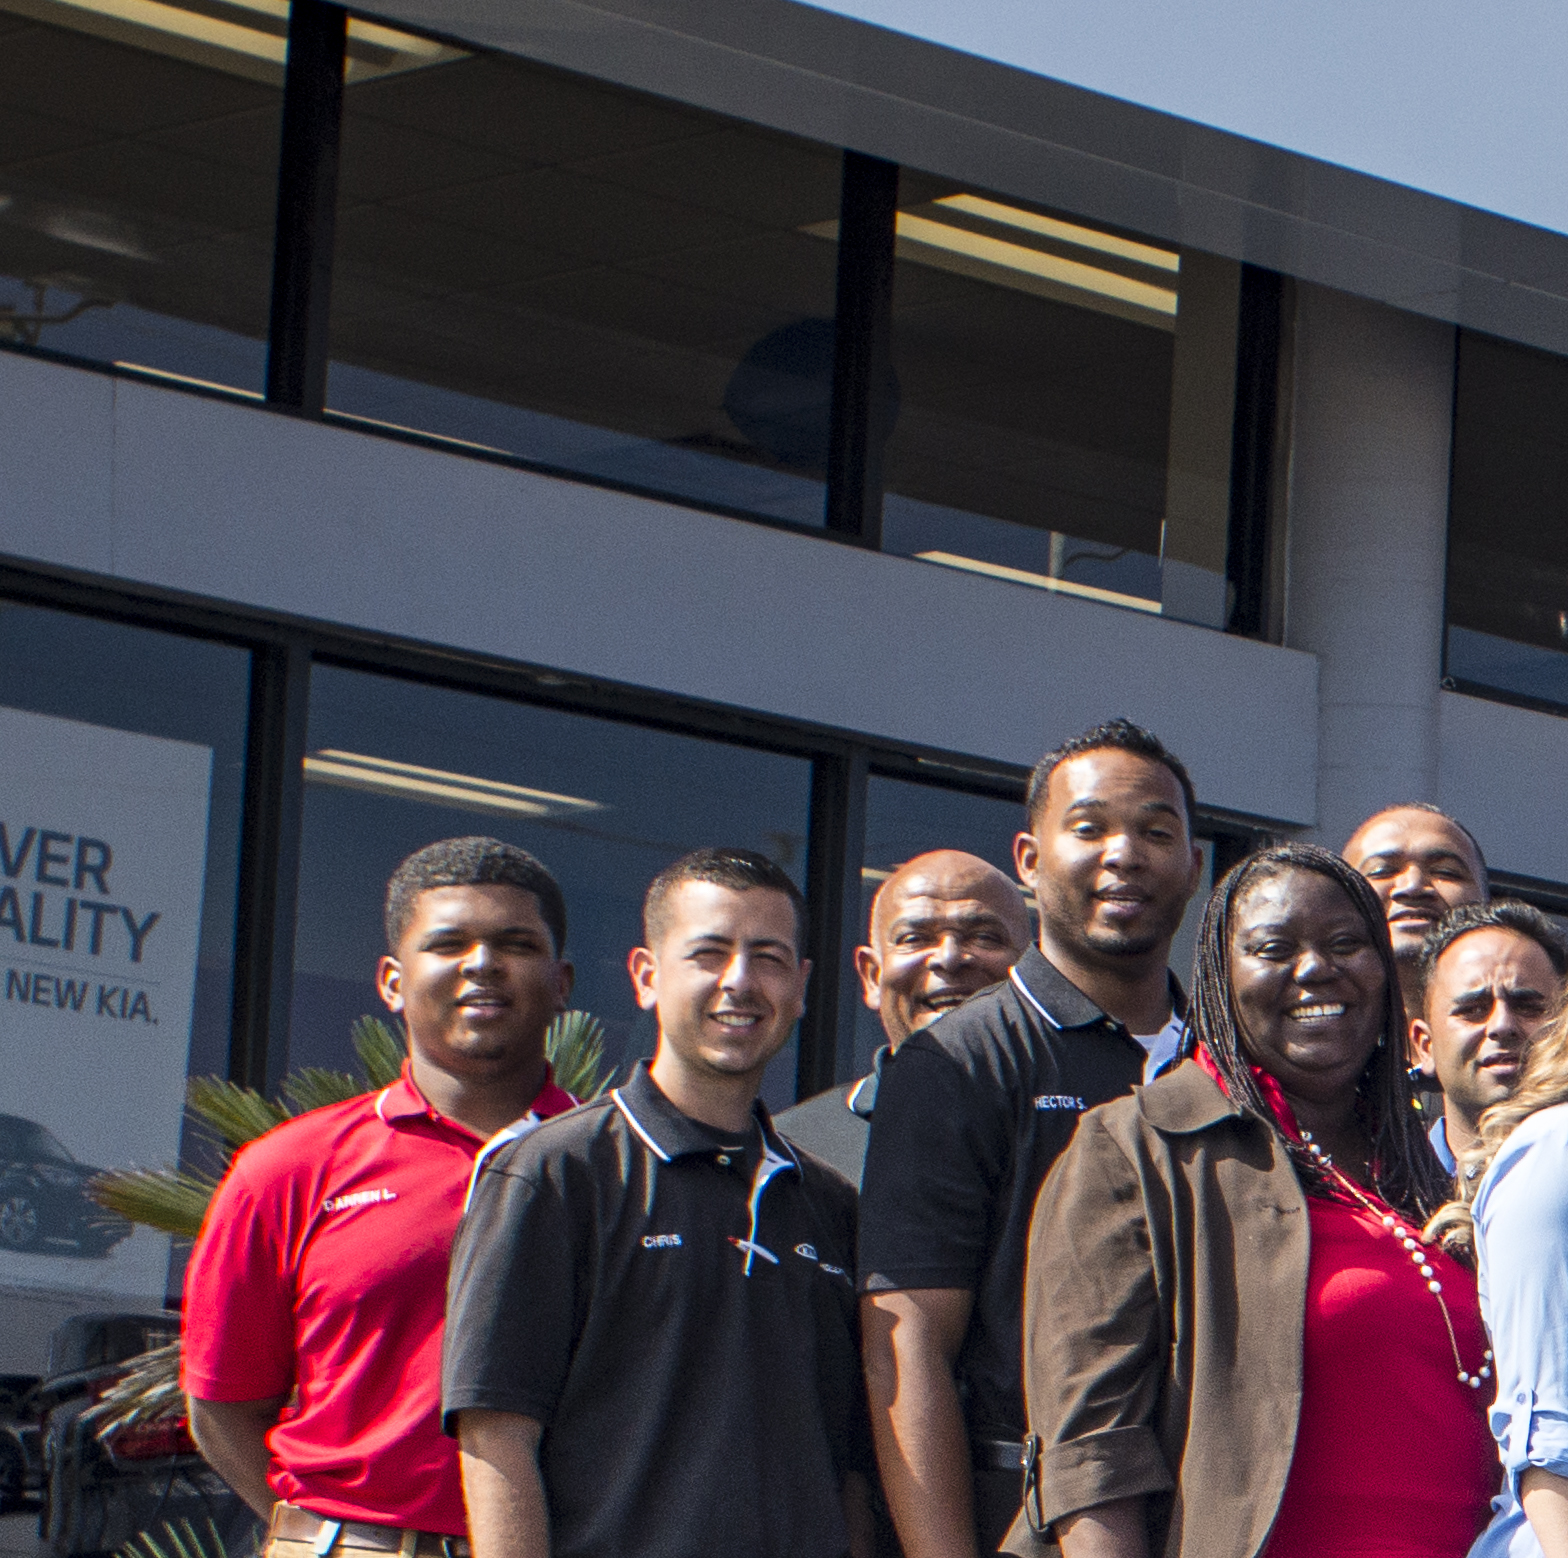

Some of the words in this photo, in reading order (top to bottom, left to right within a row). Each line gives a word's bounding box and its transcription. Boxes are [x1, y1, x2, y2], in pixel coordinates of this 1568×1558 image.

[0, 821, 114, 895] VER
[5, 968, 89, 1012] NEW
[95, 984, 159, 1026] KIA.
[1034, 1094, 1075, 1111] HECTOR
[641, 1233, 683, 1249] CHRIS
